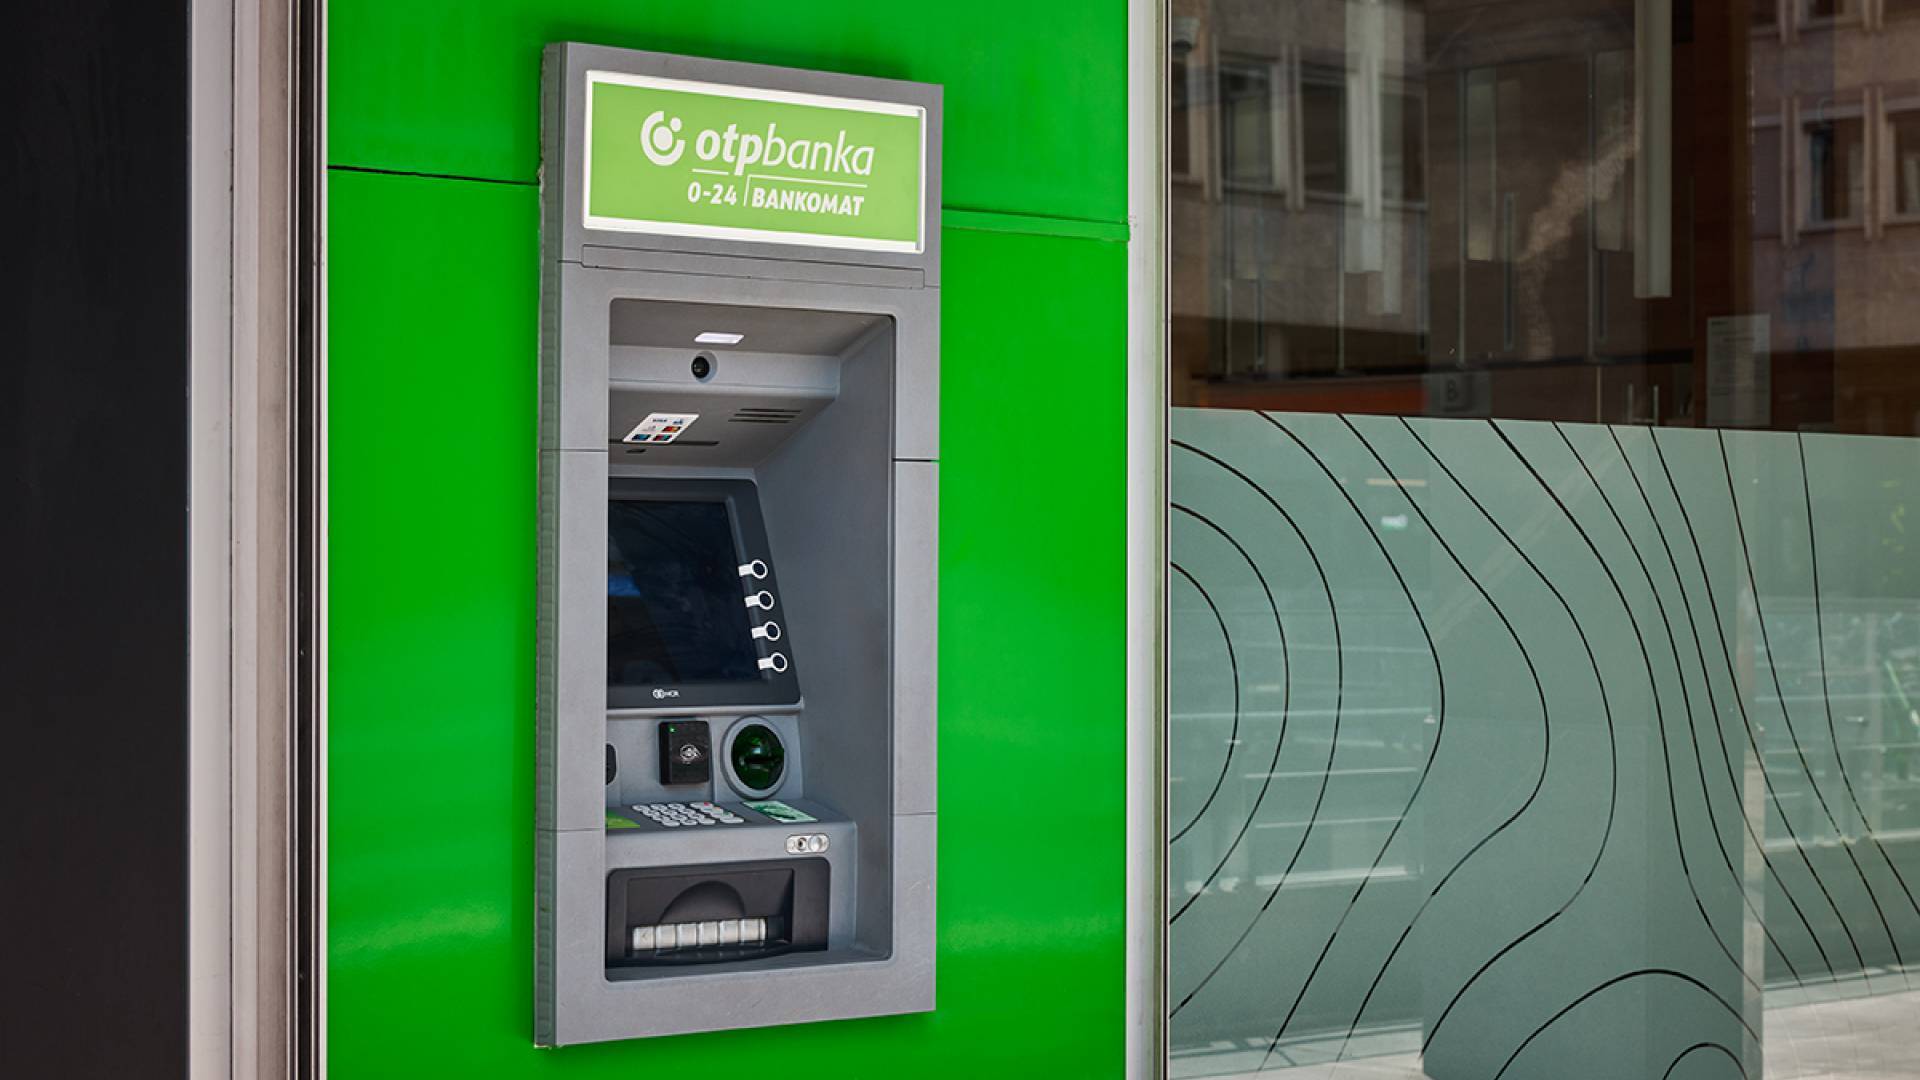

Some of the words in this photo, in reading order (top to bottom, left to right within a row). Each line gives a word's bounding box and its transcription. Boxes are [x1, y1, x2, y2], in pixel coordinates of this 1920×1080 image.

[695, 123, 875, 176] otpbanka
[687, 181, 737, 206] 0-24
[751, 187, 865, 217] BANKOMAT
